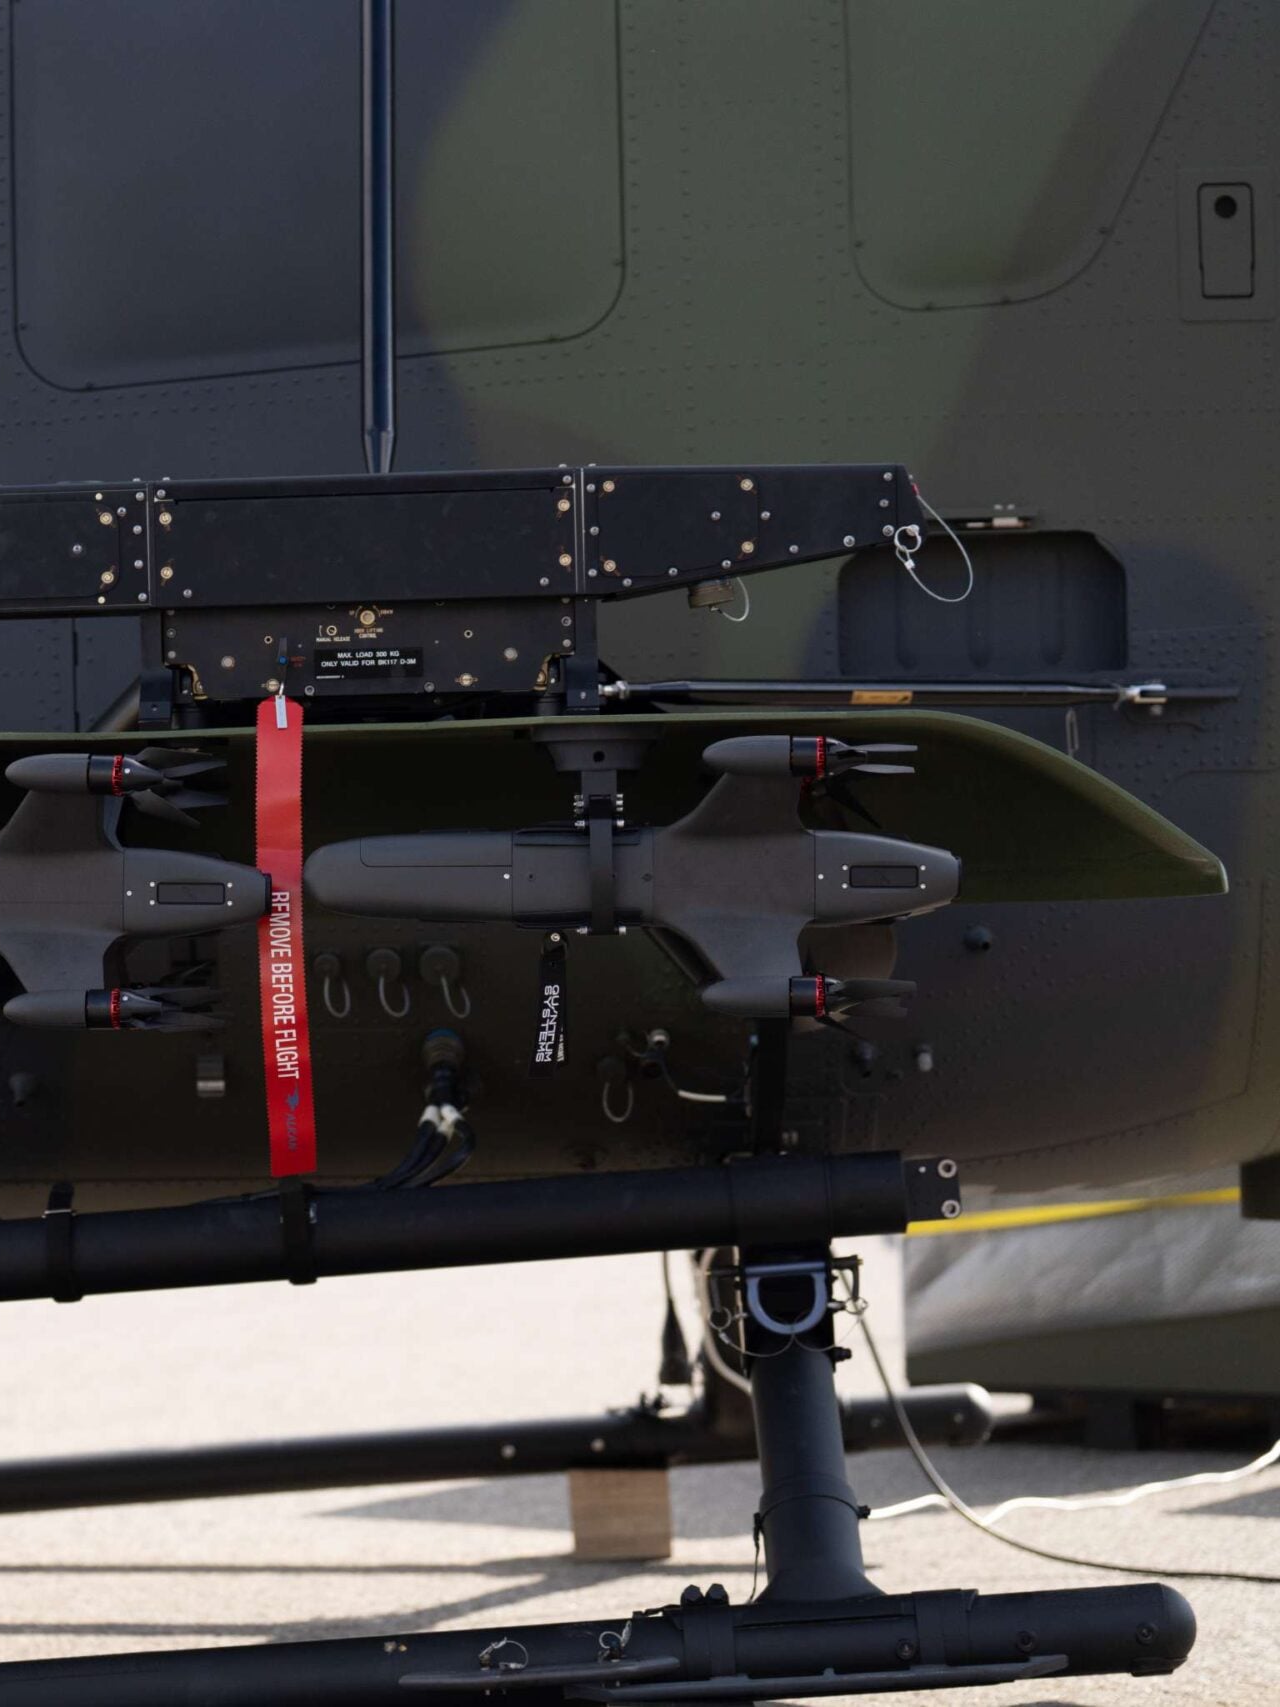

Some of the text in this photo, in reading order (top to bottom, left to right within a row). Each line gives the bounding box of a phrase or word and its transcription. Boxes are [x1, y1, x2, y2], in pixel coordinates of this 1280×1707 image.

[340, 659, 359, 667] VALID
[378, 658, 397, 666] BK117
[270, 892, 300, 1079] REMOVE BEFORE FLIGHT
[535, 984, 553, 1063] SYSTEMS
